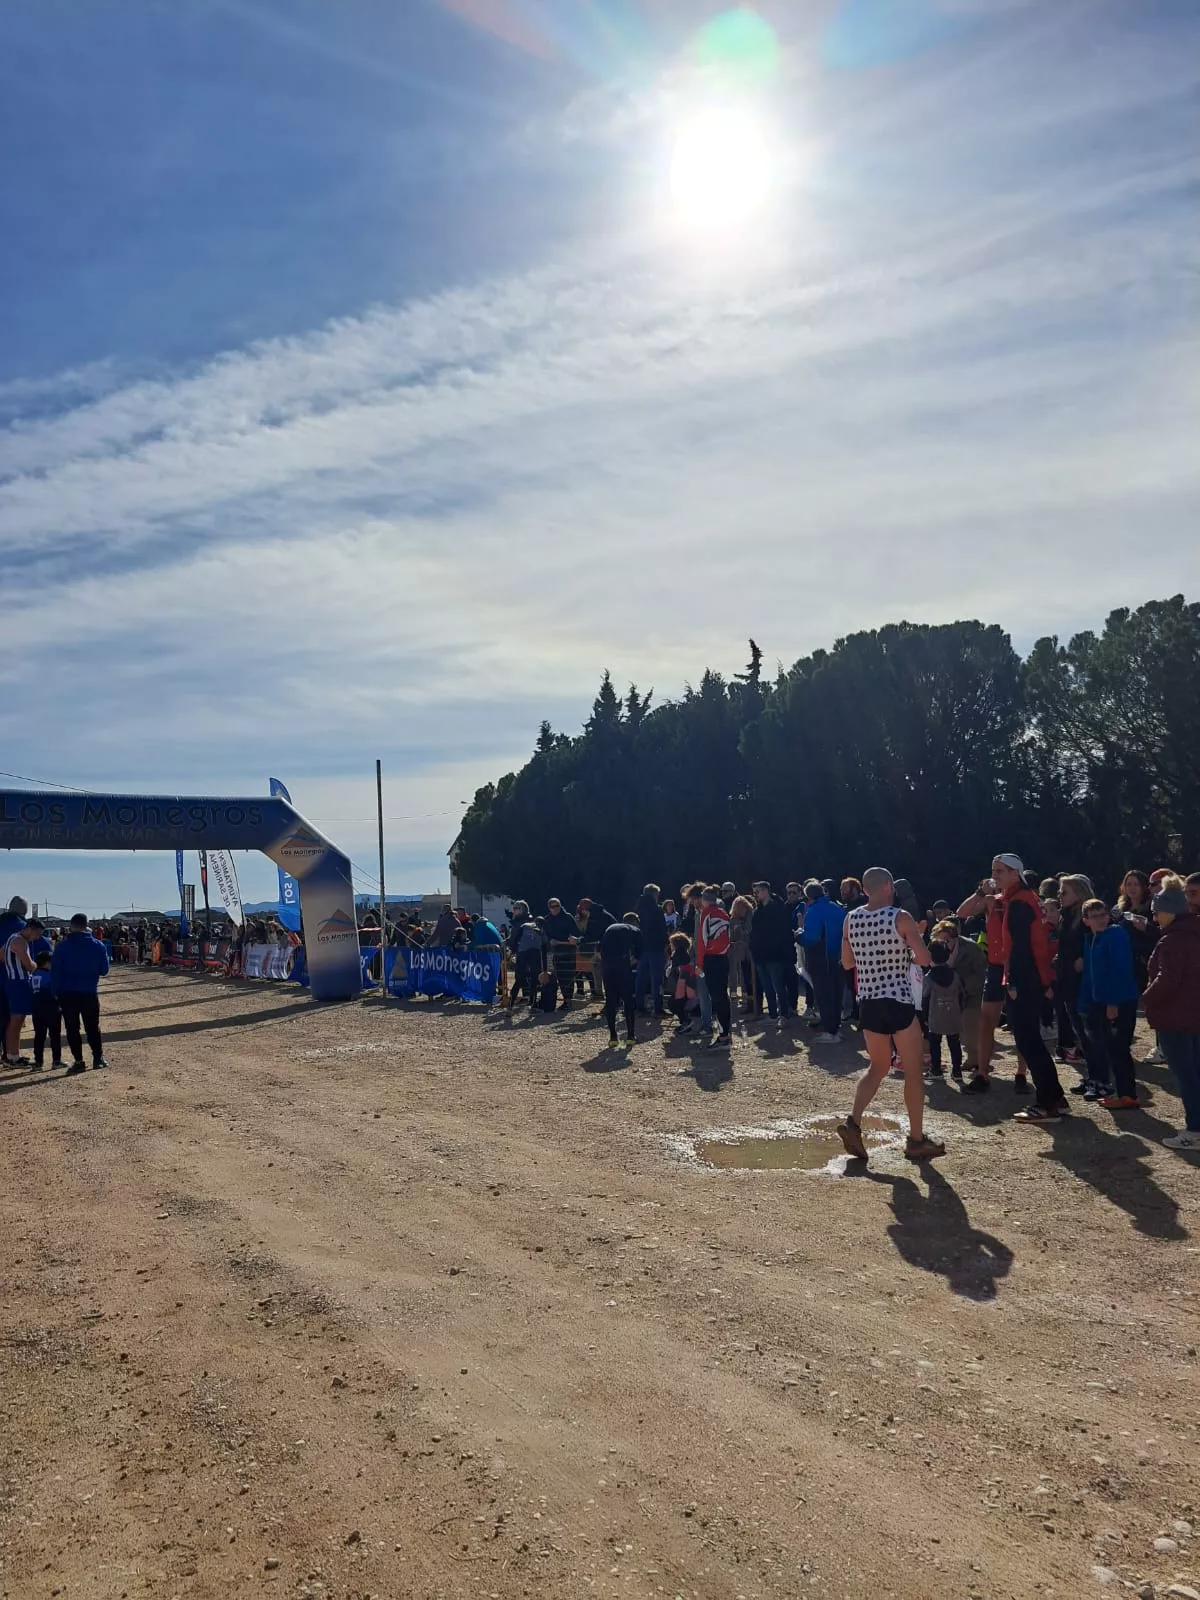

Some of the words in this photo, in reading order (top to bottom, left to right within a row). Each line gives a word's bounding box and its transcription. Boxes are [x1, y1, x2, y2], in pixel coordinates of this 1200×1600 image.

[0, 796, 66, 823] Los
[82, 801, 262, 832] Monegros
[410, 950, 425, 969] Los
[425, 951, 490, 981] Monegros
